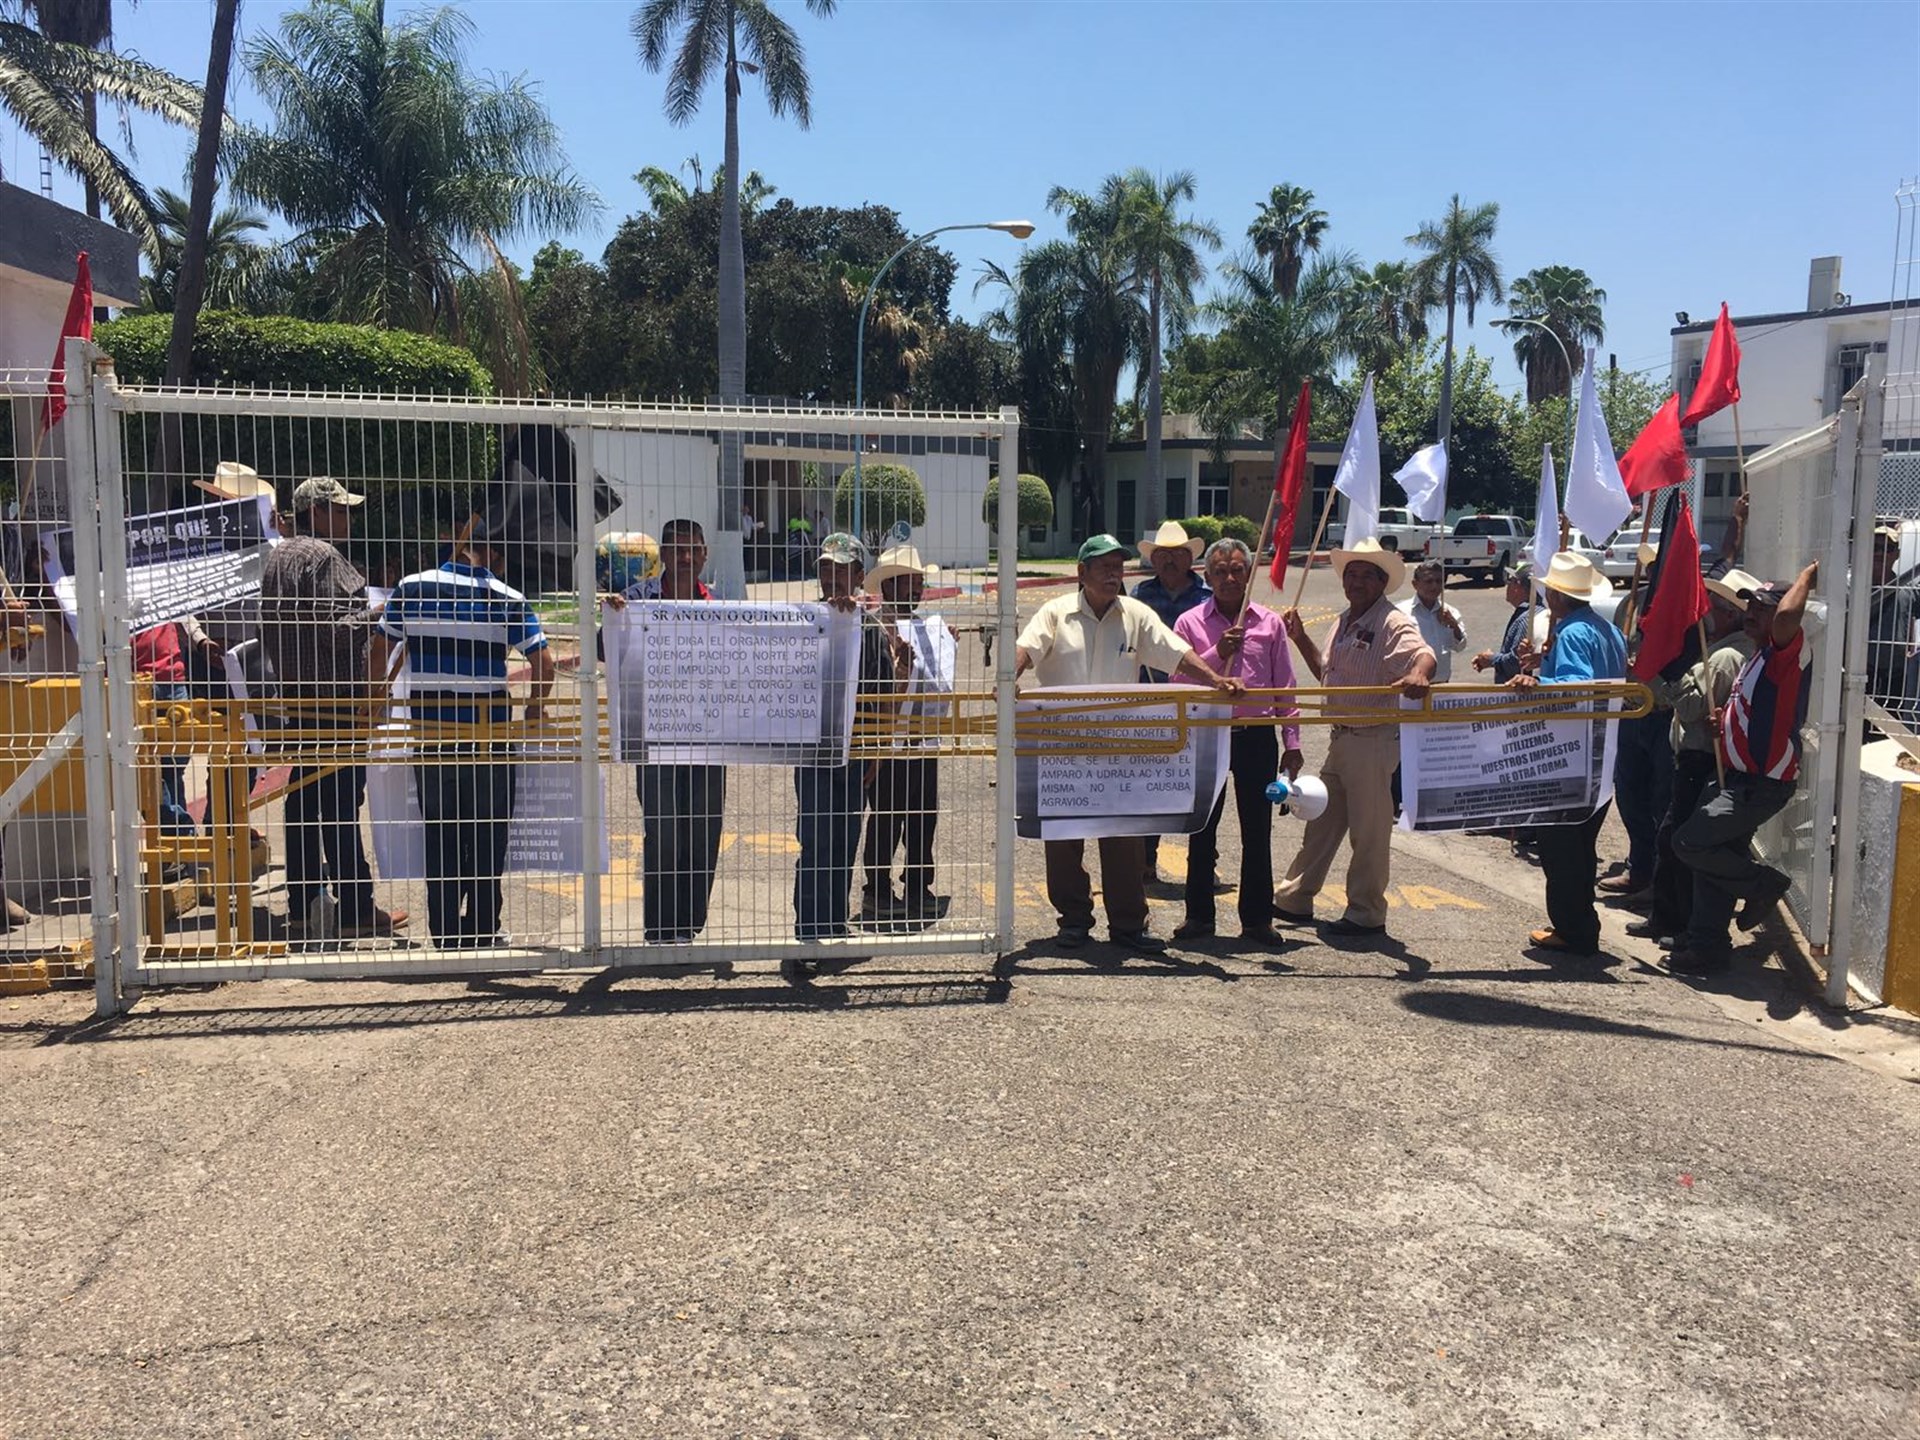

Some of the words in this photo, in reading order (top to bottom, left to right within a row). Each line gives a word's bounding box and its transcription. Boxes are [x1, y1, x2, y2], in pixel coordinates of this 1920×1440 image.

[127, 525, 167, 549] POR
[174, 518, 211, 541] QUE
[651, 610, 668, 622] SR
[670, 610, 738, 622] ANTONIO
[742, 610, 815, 622] QUINTERO
[648, 635, 670, 647] QUE
[678, 635, 703, 647] DIGA
[710, 635, 723, 647] EL
[730, 635, 796, 647] ORGANISMO
[803, 635, 817, 647] DE
[648, 651, 692, 661] CUENCA
[699, 651, 747, 661] PACIFICO
[753, 651, 788, 661] NORTE
[795, 651, 817, 661] POR
[648, 665, 670, 675] QUE
[678, 665, 730, 675] IMPUGNO
[738, 665, 750, 675] LA
[757, 665, 817, 675] SENTENCIA
[648, 680, 688, 689] DONDE
[699, 680, 713, 689] SE
[725, 680, 737, 689] LE
[749, 680, 793, 689] OTORGO
[804, 680, 817, 689] EL
[648, 694, 694, 704] AMPARO
[699, 694, 706, 704] A
[711, 694, 753, 704] UDRALA
[759, 694, 772, 704] AC
[777, 694, 783, 704] Y
[789, 694, 798, 704] SI
[804, 694, 816, 704] LA
[1433, 695, 1516, 712] INTERVENCION
[649, 709, 685, 718] MISMA
[706, 709, 719, 718] NO
[738, 709, 749, 718] LE
[767, 709, 816, 718] CAUSABA
[648, 723, 702, 733] AGRAVIOS
[1041, 728, 1082, 737] CUENCA
[1086, 728, 1129, 738] PACIFICO
[1134, 728, 1166, 737] NORTE
[1506, 727, 1519, 740] NO
[1520, 720, 1547, 735] SIRVE
[1502, 732, 1555, 755] UTILIZEMOS
[1041, 756, 1075, 765] DONDE
[1086, 756, 1098, 765] SE
[1109, 756, 1120, 765] LE
[1130, 756, 1169, 765] OTORGO
[1179, 756, 1190, 765] EL
[1481, 752, 1528, 775] NUESTROS
[1530, 740, 1581, 763] IMPUESTOS
[1041, 769, 1082, 779] AMPARO
[1086, 769, 1093, 779] A
[1097, 769, 1135, 779] UDRALA
[1139, 769, 1152, 779] AC
[1155, 769, 1161, 779] Y
[1166, 769, 1175, 779] SI
[1179, 769, 1190, 779] LA
[1499, 772, 1511, 784] DE
[1512, 766, 1536, 783] OTRA
[1537, 759, 1568, 776] FORMA
[1041, 783, 1075, 792] MISMA
[1090, 783, 1104, 792] NO
[1120, 783, 1132, 792] LE
[1147, 783, 1190, 792] CAUSABA
[1041, 797, 1089, 806] AGRAVIOS
